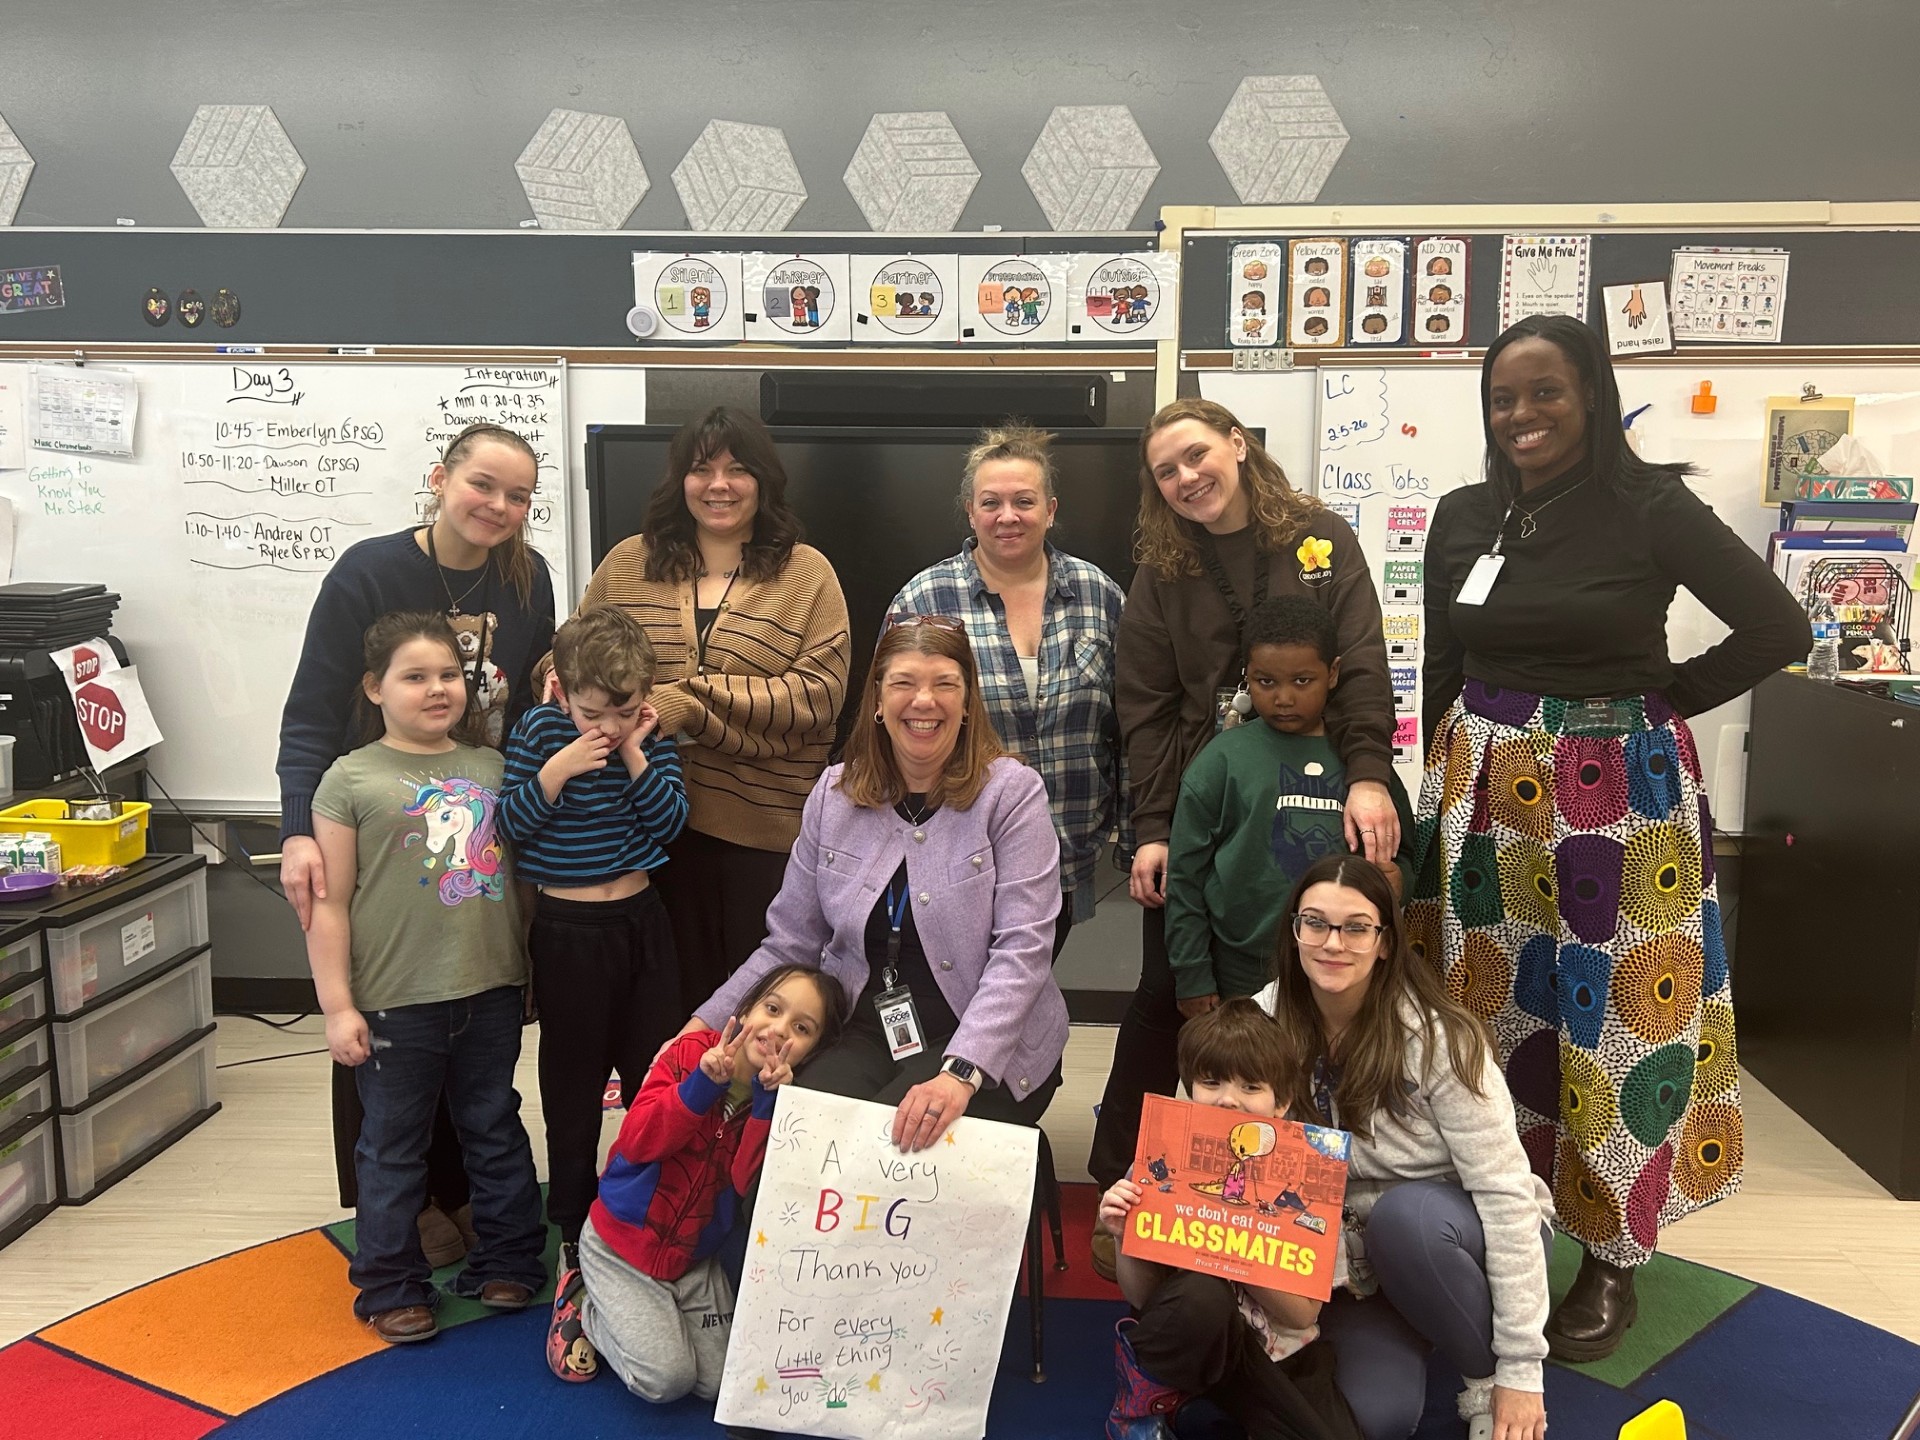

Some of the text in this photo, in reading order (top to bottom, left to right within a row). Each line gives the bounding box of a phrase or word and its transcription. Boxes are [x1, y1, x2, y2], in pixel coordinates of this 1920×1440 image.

[1233, 246, 1280, 258] Green Zone
[1295, 246, 1341, 256] Yellow Zone
[1421, 243, 1460, 254] RED ZONE
[1515, 245, 1578, 259] Give Me Five!
[670, 266, 714, 283] Silent
[1694, 260, 1766, 272] Movement Breaks
[7, 271, 43, 282] HAVE A
[773, 269, 825, 285] Whisper
[881, 271, 933, 286] Partner
[988, 272, 1044, 282] Presentation
[2, 281, 51, 298] GREAT
[985, 291, 993, 305] 4
[17, 296, 40, 306] DAY!
[667, 293, 678, 310] 1
[770, 296, 782, 309] 2
[876, 294, 888, 308] 3
[1617, 339, 1639, 349] hand
[233, 367, 294, 397] Day 3
[464, 367, 548, 386] Integration
[1326, 374, 1355, 400] LC
[216, 421, 254, 441] 10:45
[267, 421, 337, 446] Emberlyn
[340, 417, 384, 444] (SPSG)
[1328, 420, 1368, 441] 2-5-26
[263, 454, 308, 469] Dawson
[317, 455, 360, 472] (SPSG)
[29, 461, 92, 485] Getting to
[1323, 464, 1372, 491] Class
[38, 481, 106, 499] Know You
[270, 475, 310, 494] Miller
[315, 477, 337, 493] OT
[69, 500, 106, 515] Steve
[254, 522, 303, 542] Andrew
[310, 526, 333, 543] OT
[260, 543, 290, 564] Rylee
[1831, 584, 1849, 605] MIN
[1863, 578, 1877, 594] BE
[76, 657, 98, 679] STOP
[78, 698, 123, 734] STOP
[1392, 732, 1415, 744] elper
[821, 1140, 939, 1203] A very
[815, 1189, 911, 1240] BIG
[1175, 1203, 1281, 1236] we don't eat our
[1136, 1211, 1317, 1276] CLASSMATES
[790, 1249, 881, 1282] Thank
[778, 1308, 893, 1344] For every
[774, 1344, 892, 1370] Little thing
[778, 1381, 846, 1416] you do
